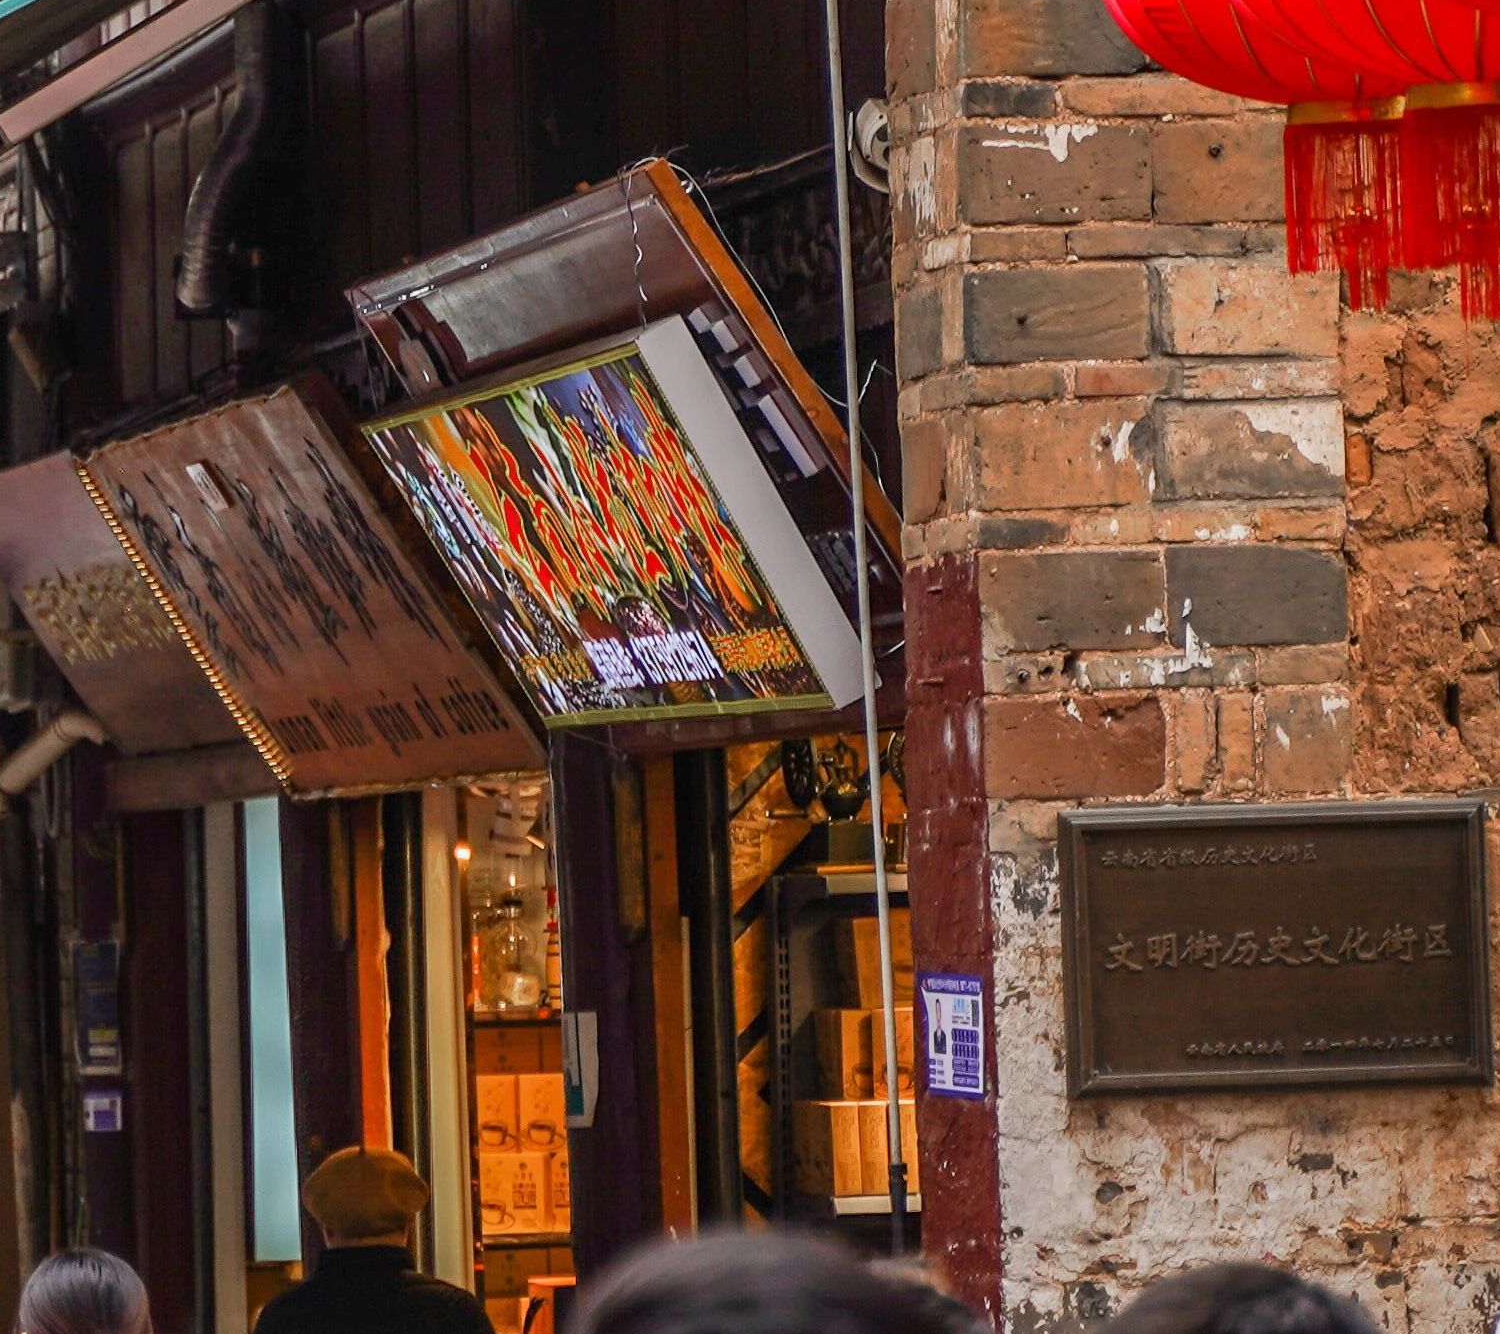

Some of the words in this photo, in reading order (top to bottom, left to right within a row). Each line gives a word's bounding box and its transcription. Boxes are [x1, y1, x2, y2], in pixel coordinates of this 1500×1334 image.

[464, 371, 761, 621] 云南小粒咖啡
[1105, 925, 1454, 972] 文明街历史文化街区
